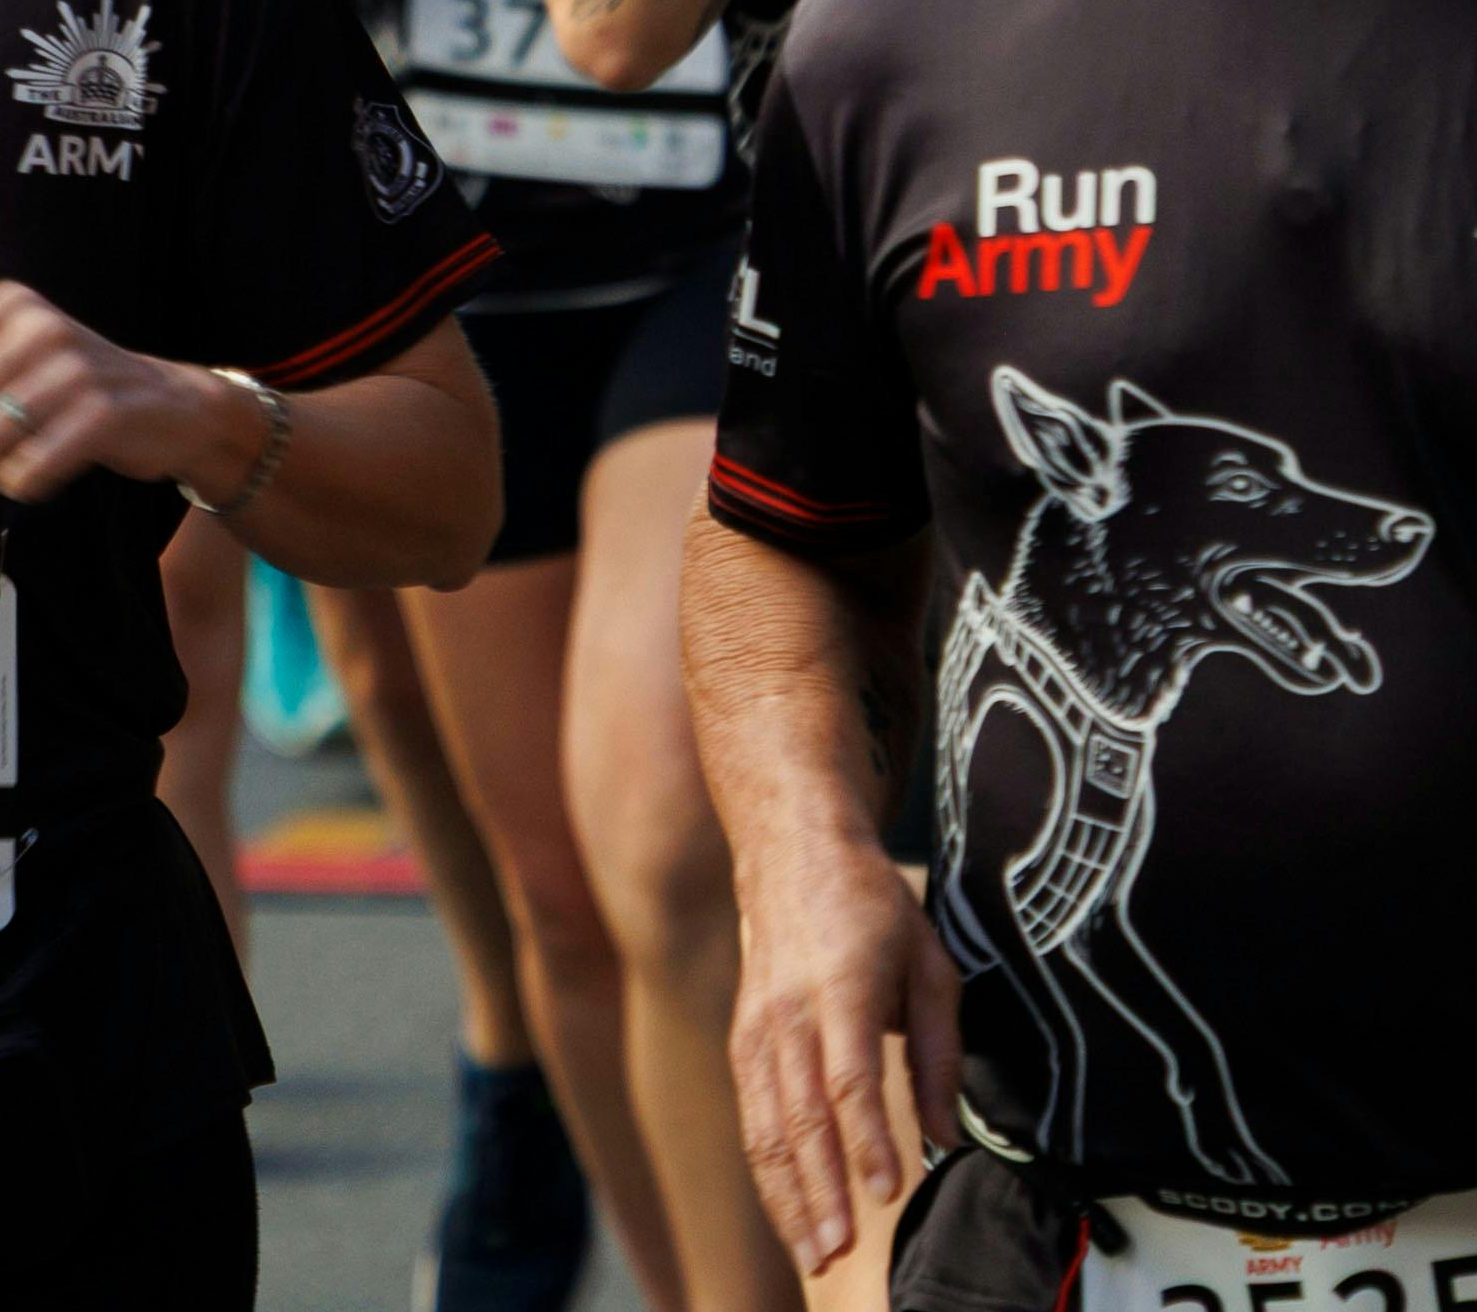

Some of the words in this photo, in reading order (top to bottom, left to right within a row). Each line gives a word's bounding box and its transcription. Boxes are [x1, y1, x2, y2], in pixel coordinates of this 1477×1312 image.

[976, 158, 1157, 239] Run
[918, 223, 1152, 307] Army
[1246, 1256, 1302, 1276] ARMY
